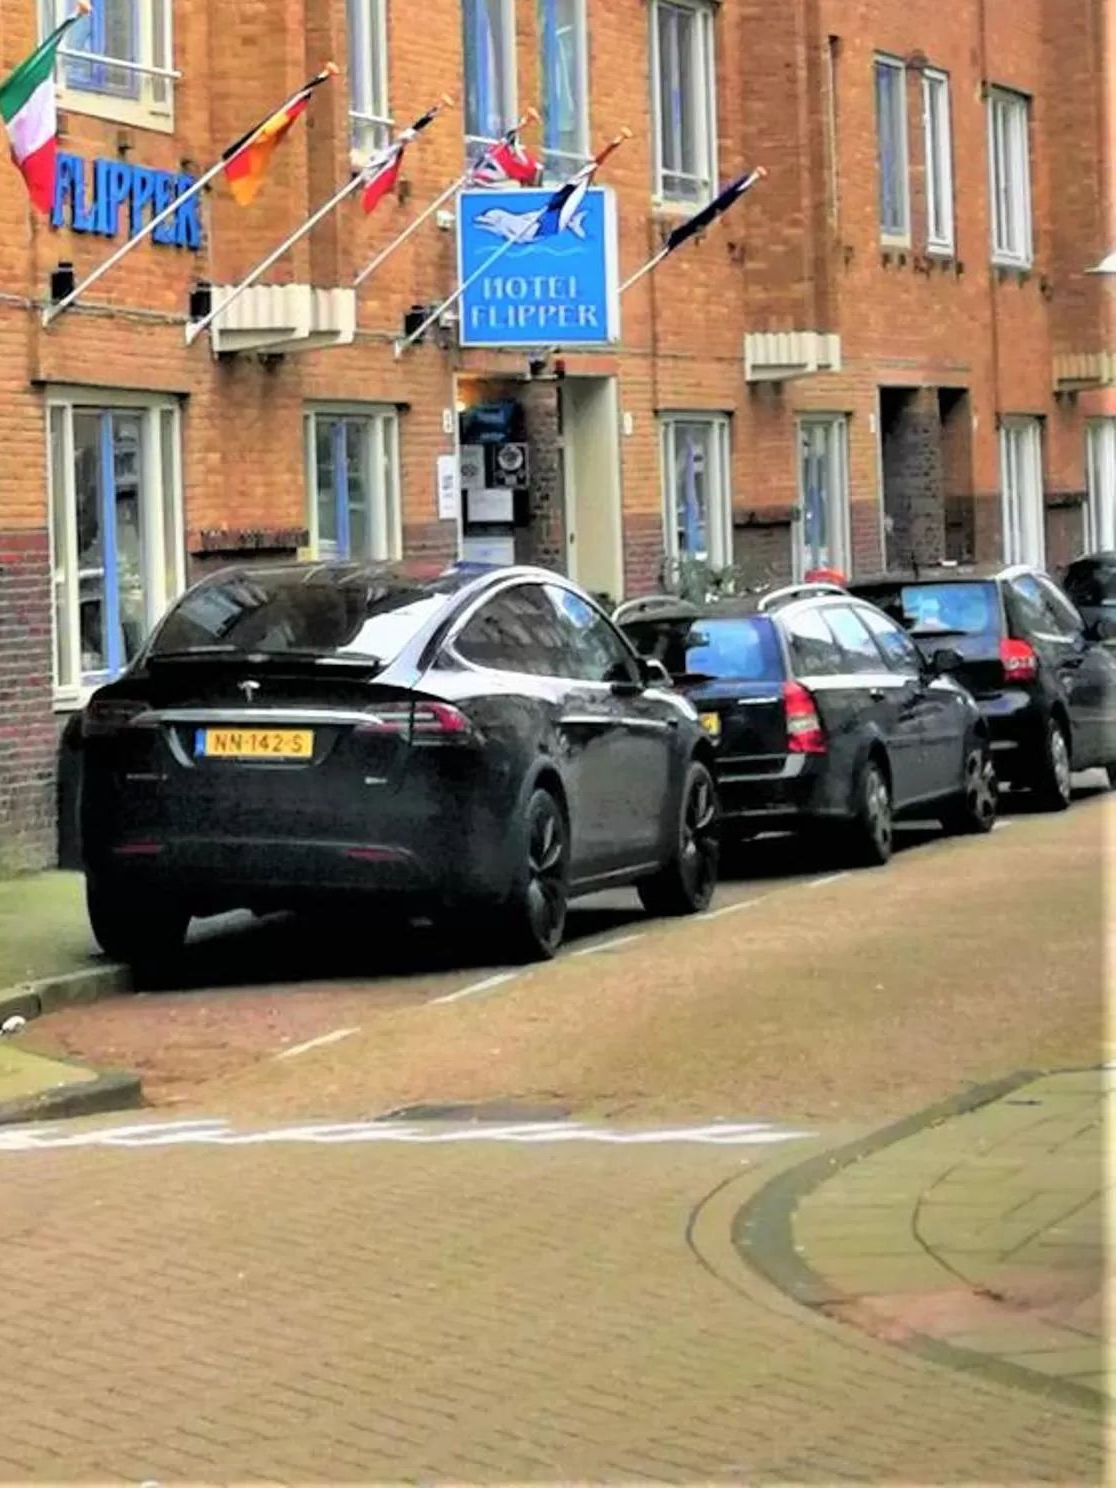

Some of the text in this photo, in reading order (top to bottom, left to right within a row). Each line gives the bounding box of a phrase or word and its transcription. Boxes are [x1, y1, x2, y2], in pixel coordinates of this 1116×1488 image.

[50, 151, 204, 250] FLIPPER
[483, 275, 578, 301] HOTEL
[470, 304, 599, 330] FLIPPER
[214, 733, 304, 753] NN-142-S
